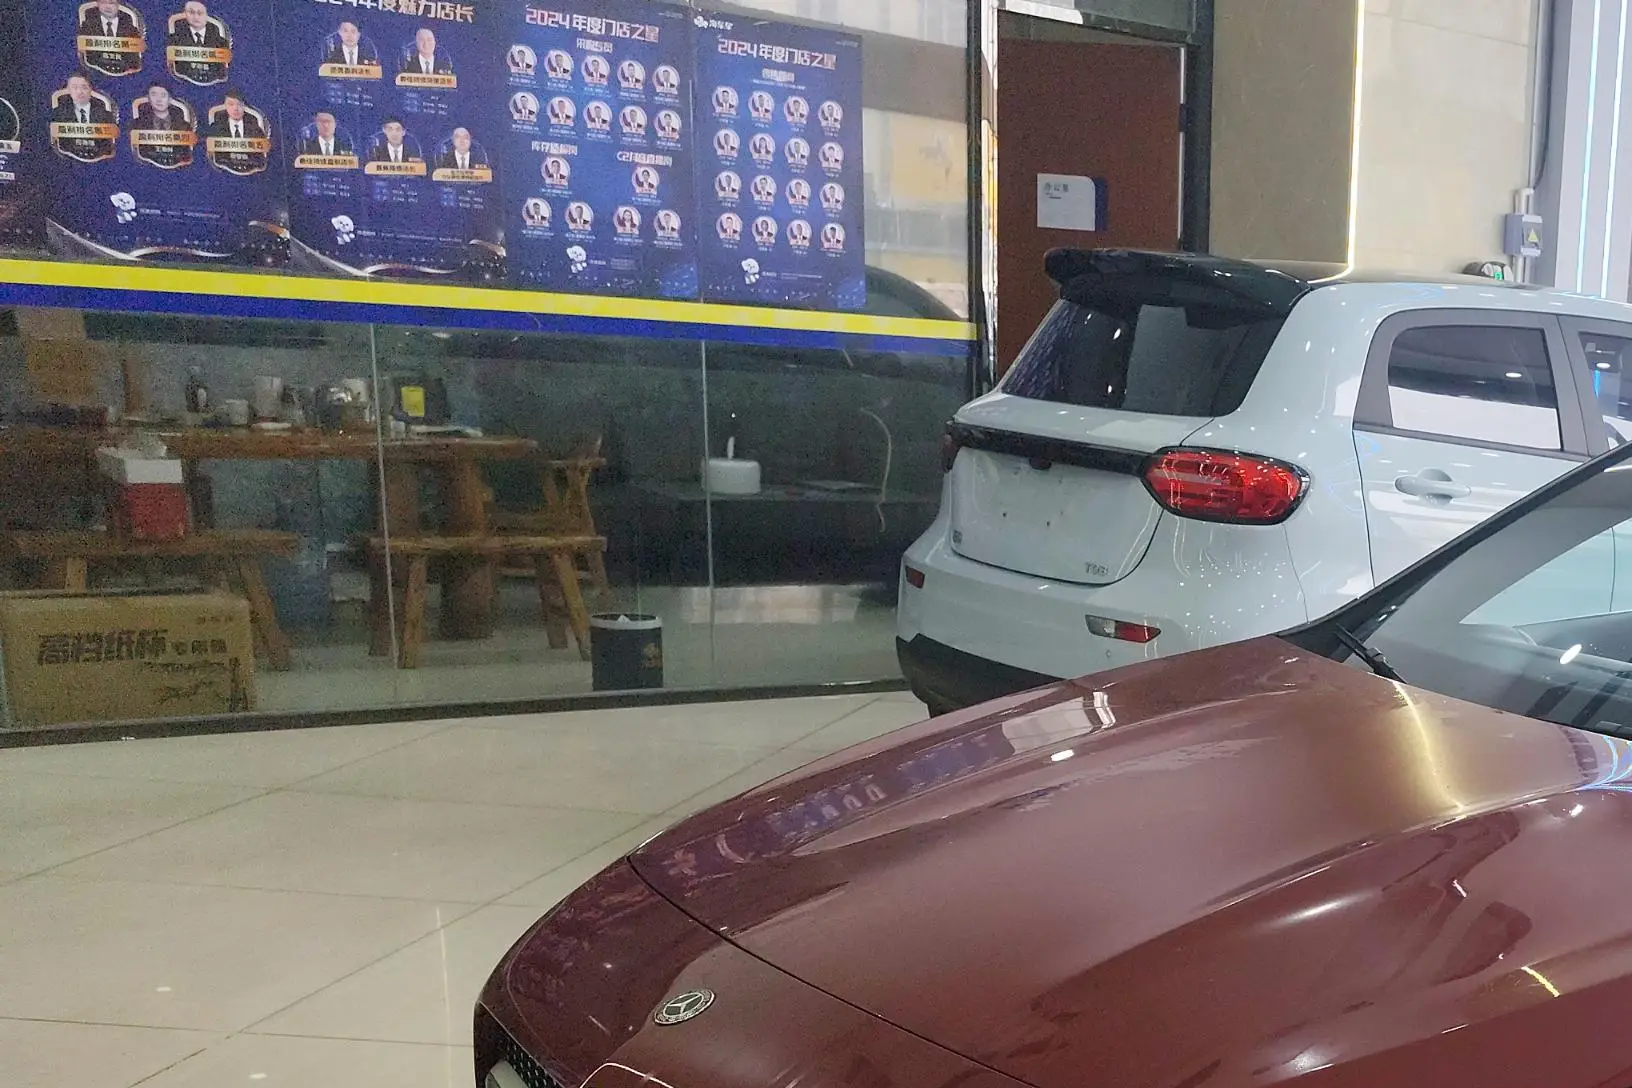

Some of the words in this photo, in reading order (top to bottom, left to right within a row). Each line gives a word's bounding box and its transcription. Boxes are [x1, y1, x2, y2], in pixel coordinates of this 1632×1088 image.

[307, 0, 475, 23] 年度魅力店长
[525, 8, 660, 43] 2024年度门店之星
[717, 38, 837, 70] 2024年度门店之星
